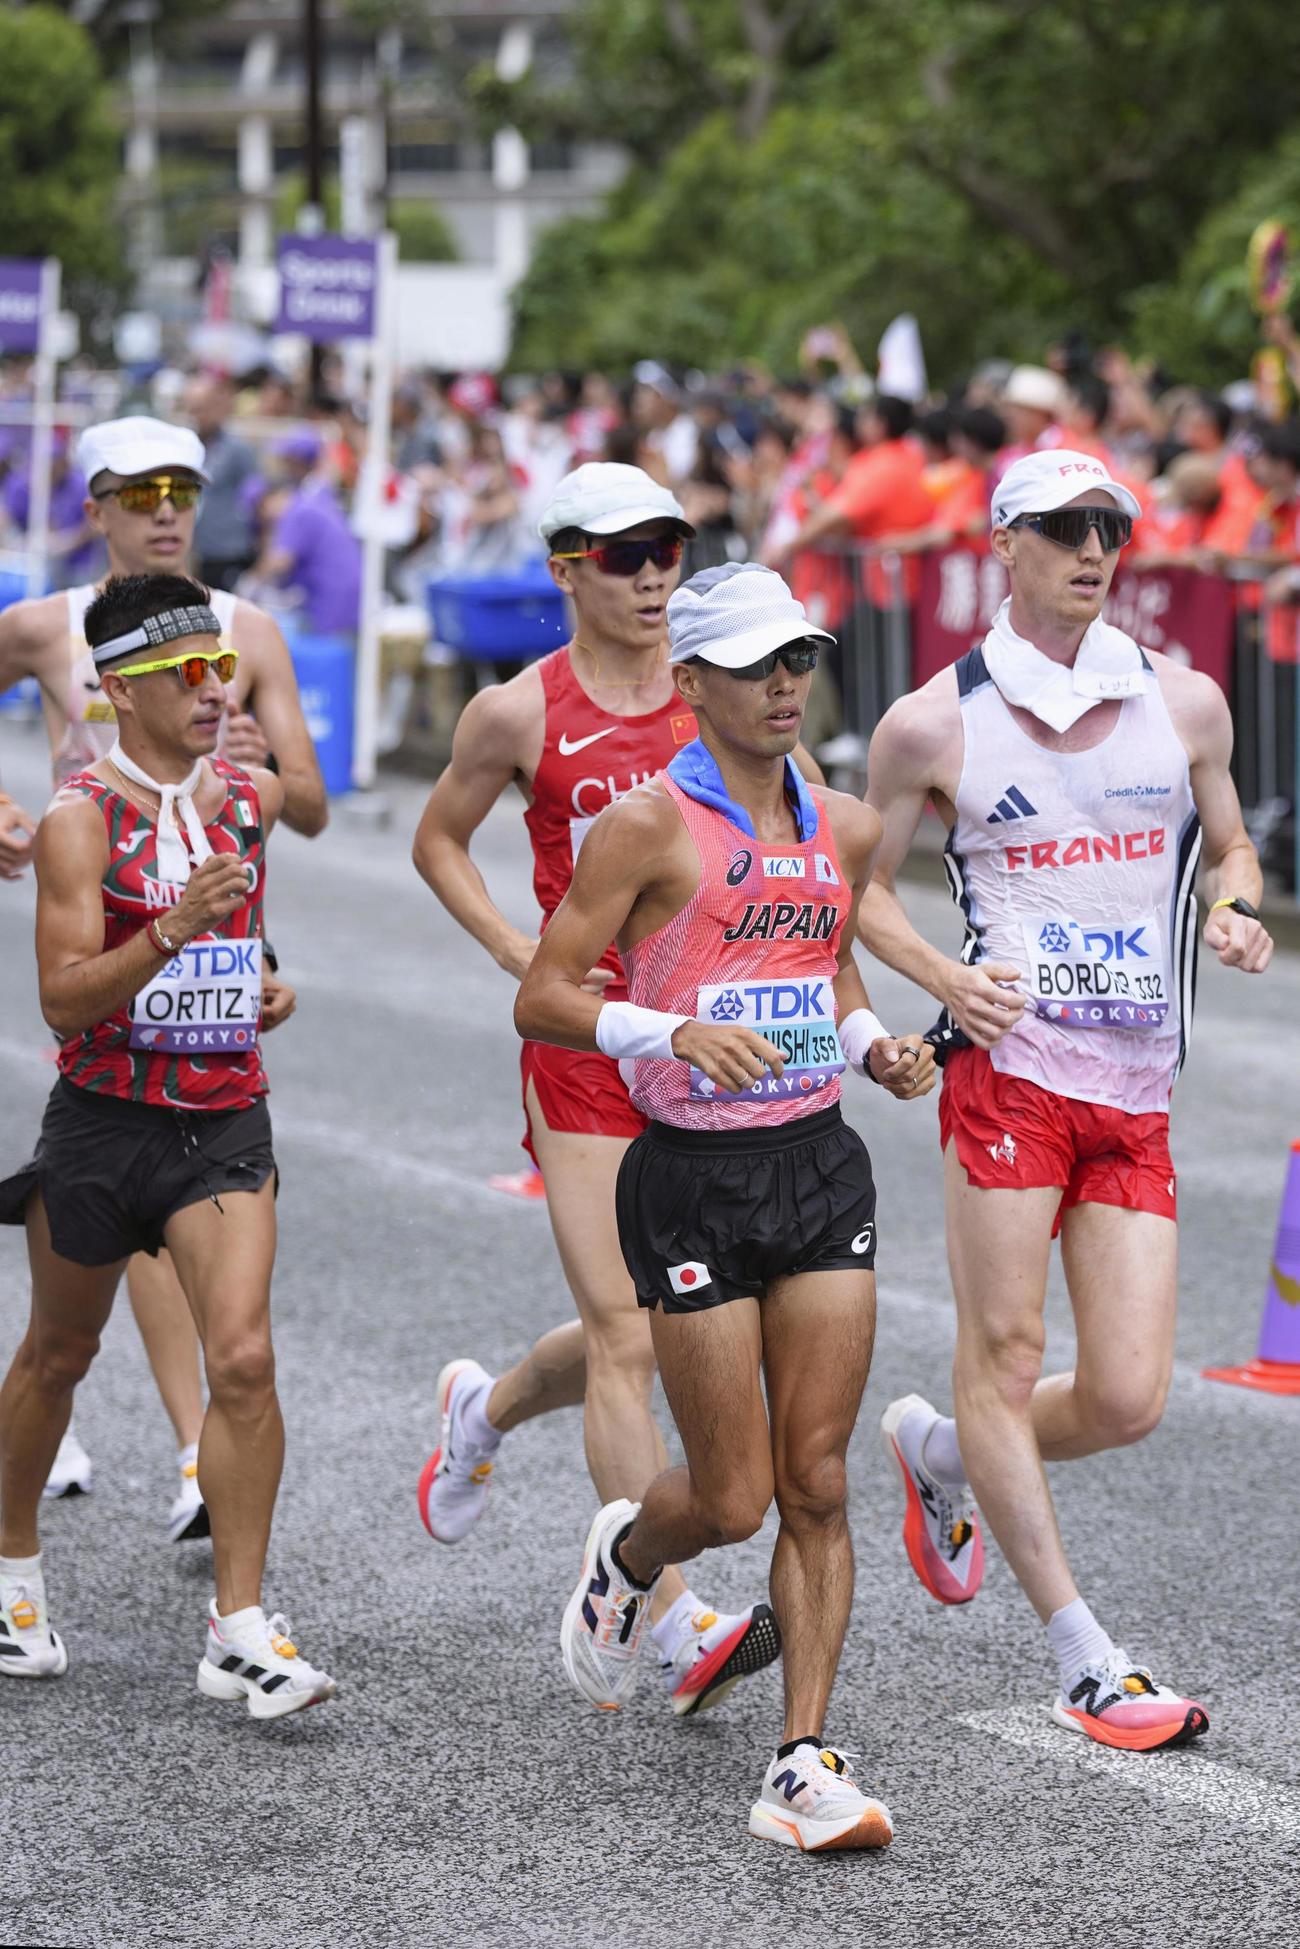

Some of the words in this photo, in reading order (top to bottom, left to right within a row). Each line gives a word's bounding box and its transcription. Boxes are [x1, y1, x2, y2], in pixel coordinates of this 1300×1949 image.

[281, 249, 373, 291] Sports
[1104, 788, 1134, 798] Crédit
[1145, 785, 1171, 795] Mutuel
[1006, 827, 1165, 871] FRANCE
[765, 858, 803, 877] ACN
[723, 901, 838, 943] JAPAN
[184, 945, 256, 977] TDK
[744, 983, 825, 1021] TDK
[1135, 974, 1163, 1000] 332
[146, 988, 243, 1021] ORTIZ
[812, 1035, 838, 1064] 359
